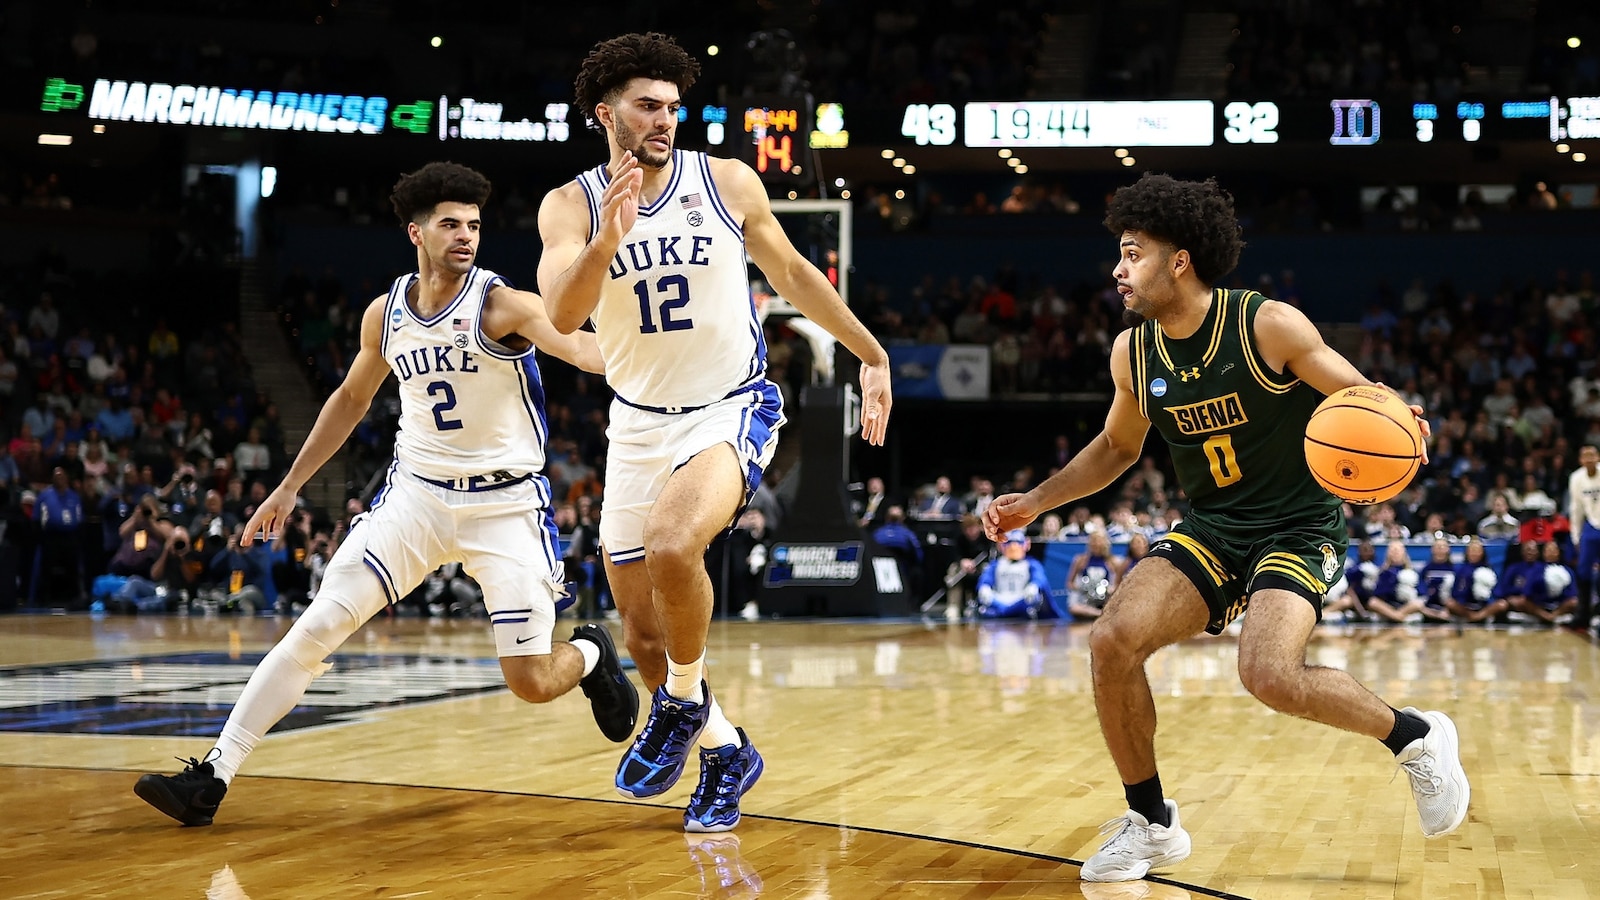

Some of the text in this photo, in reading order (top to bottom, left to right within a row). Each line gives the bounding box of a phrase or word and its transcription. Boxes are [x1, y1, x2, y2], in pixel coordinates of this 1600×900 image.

[901, 103, 957, 146] 43
[989, 107, 1091, 140] 19:44
[1223, 102, 1280, 145] 32
[757, 135, 792, 173] 14
[633, 273, 694, 334] 12
[394, 345, 480, 382] DUKE
[426, 380, 464, 431] 2
[1174, 396, 1245, 433] SIENA
[1202, 433, 1243, 488] 0
[786, 546, 838, 564] MARCH
